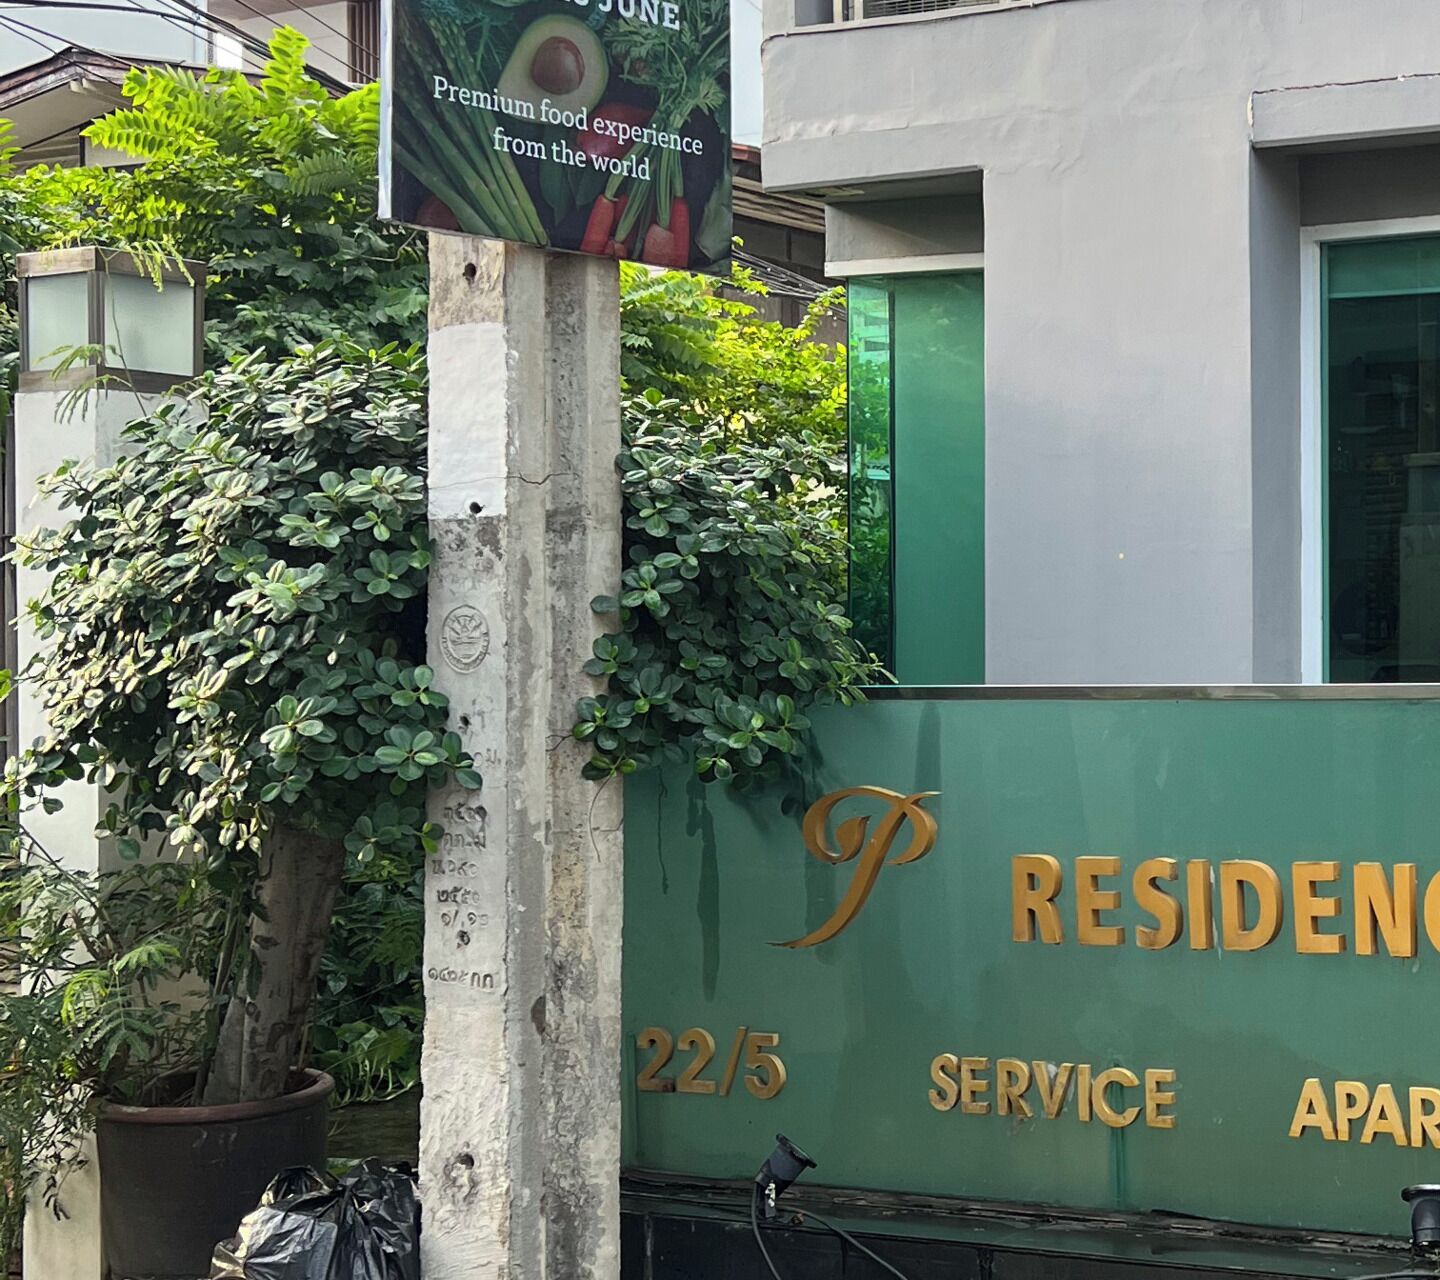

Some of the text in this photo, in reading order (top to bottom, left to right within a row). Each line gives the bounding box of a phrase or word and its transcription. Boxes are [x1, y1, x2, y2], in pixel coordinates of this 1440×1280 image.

[433, 75, 703, 156] Premium food experience
[493, 127, 651, 181] from the world
[765, 785, 943, 949] P
[637, 1026, 787, 1100] 22/5
[929, 1053, 1176, 1129] SERVICE
